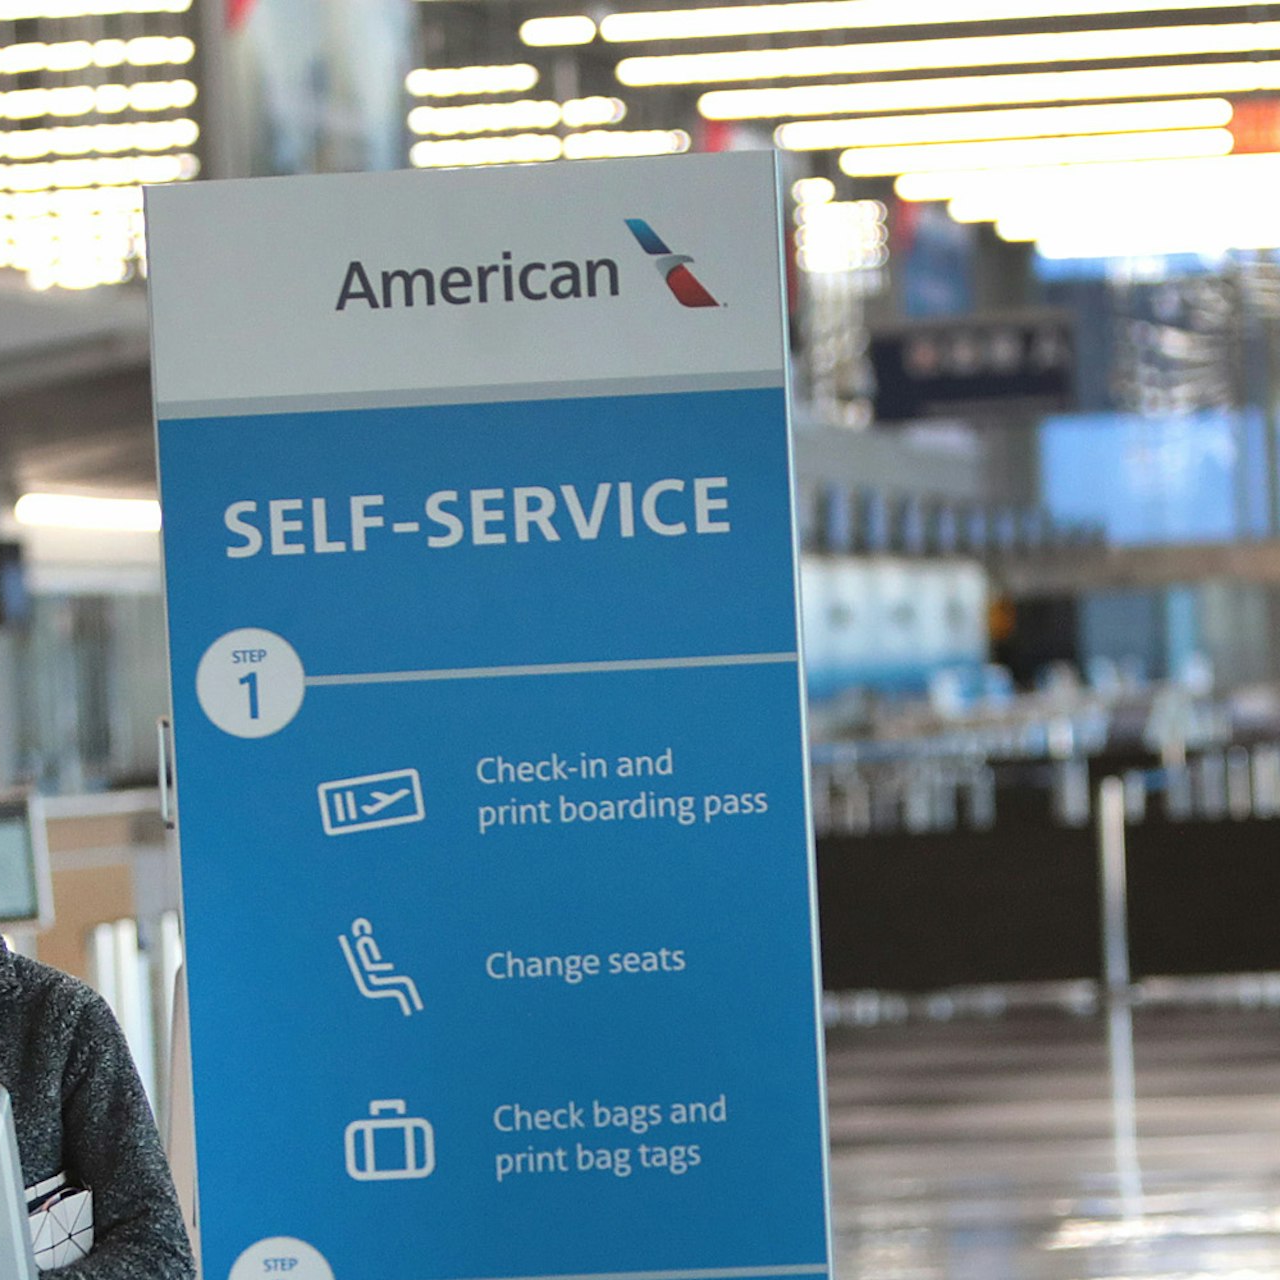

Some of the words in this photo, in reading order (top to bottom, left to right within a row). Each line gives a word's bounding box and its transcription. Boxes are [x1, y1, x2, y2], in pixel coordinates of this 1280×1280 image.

[335, 250, 620, 311] American
[224, 476, 731, 559] SELF-SERVICE
[231, 648, 268, 665] STEP
[237, 671, 260, 720] 1
[476, 752, 608, 785] Check-in
[615, 747, 674, 779] and
[478, 797, 552, 835] print
[559, 791, 697, 827] boarding
[703, 791, 769, 824] pass
[485, 950, 601, 985] Change
[607, 947, 687, 975] seats
[493, 1100, 585, 1132] Check
[592, 1099, 663, 1135] bags
[669, 1093, 727, 1125] and
[495, 1147, 569, 1183] print
[576, 1142, 632, 1178] bag
[637, 1143, 702, 1175] tags
[262, 1257, 299, 1273] STEP
